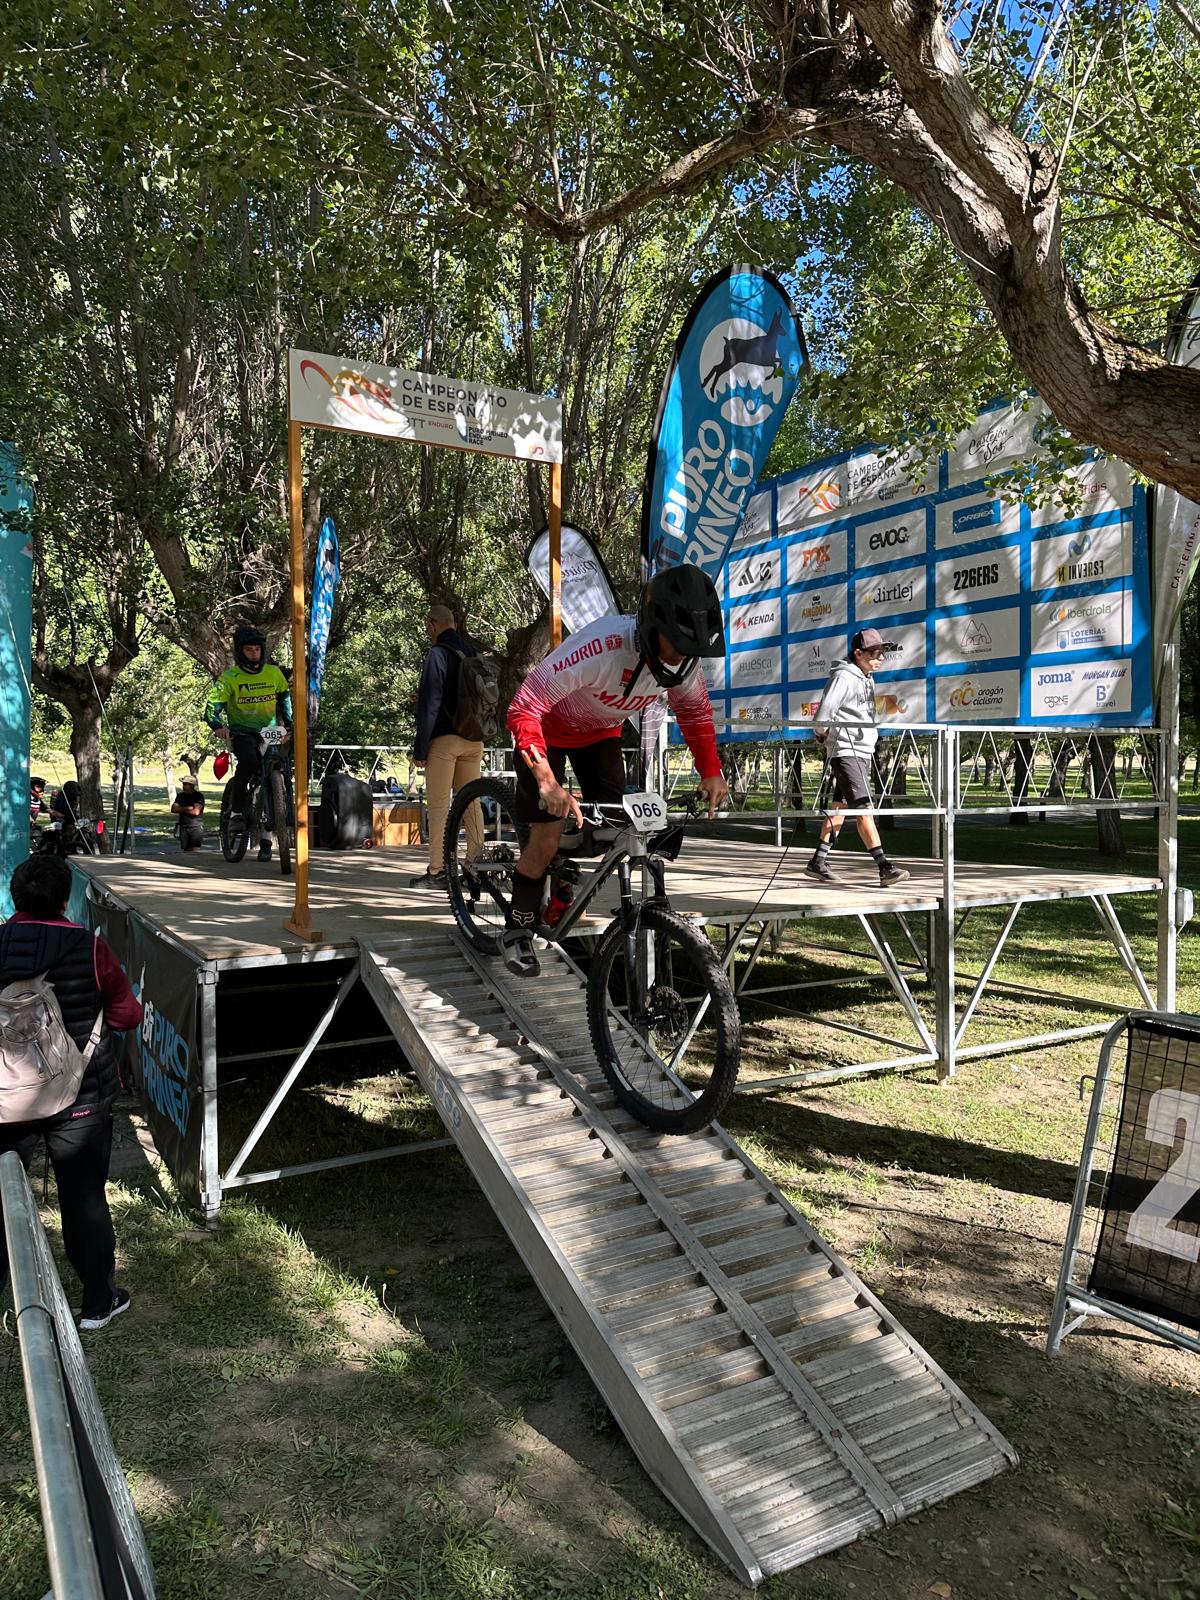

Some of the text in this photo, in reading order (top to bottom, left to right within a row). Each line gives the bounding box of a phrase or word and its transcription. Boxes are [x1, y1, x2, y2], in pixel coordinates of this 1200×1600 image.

[402, 378, 508, 408] CAMPEONATO
[402, 394, 423, 409] DE
[428, 420, 454, 430] ENDURO
[660, 419, 726, 545] PURO
[847, 480, 859, 492] DE
[958, 509, 995, 524] ORBEA
[802, 544, 831, 568] FOX
[953, 563, 999, 591] 226ERS
[873, 581, 913, 604] dirtlej
[747, 612, 775, 627] KENDA
[552, 638, 603, 675] MADRID
[1082, 670, 1109, 681] MORGAN
[1110, 667, 1128, 678] BLUE
[977, 686, 1004, 697] aragón
[972, 696, 1003, 706] ciclismo
[1096, 700, 1116, 708] travel
[264, 731, 282, 740] 065
[631, 802, 662, 818] 066
[153, 1009, 191, 1082] PURO
[1125, 1088, 1200, 1264] 2
